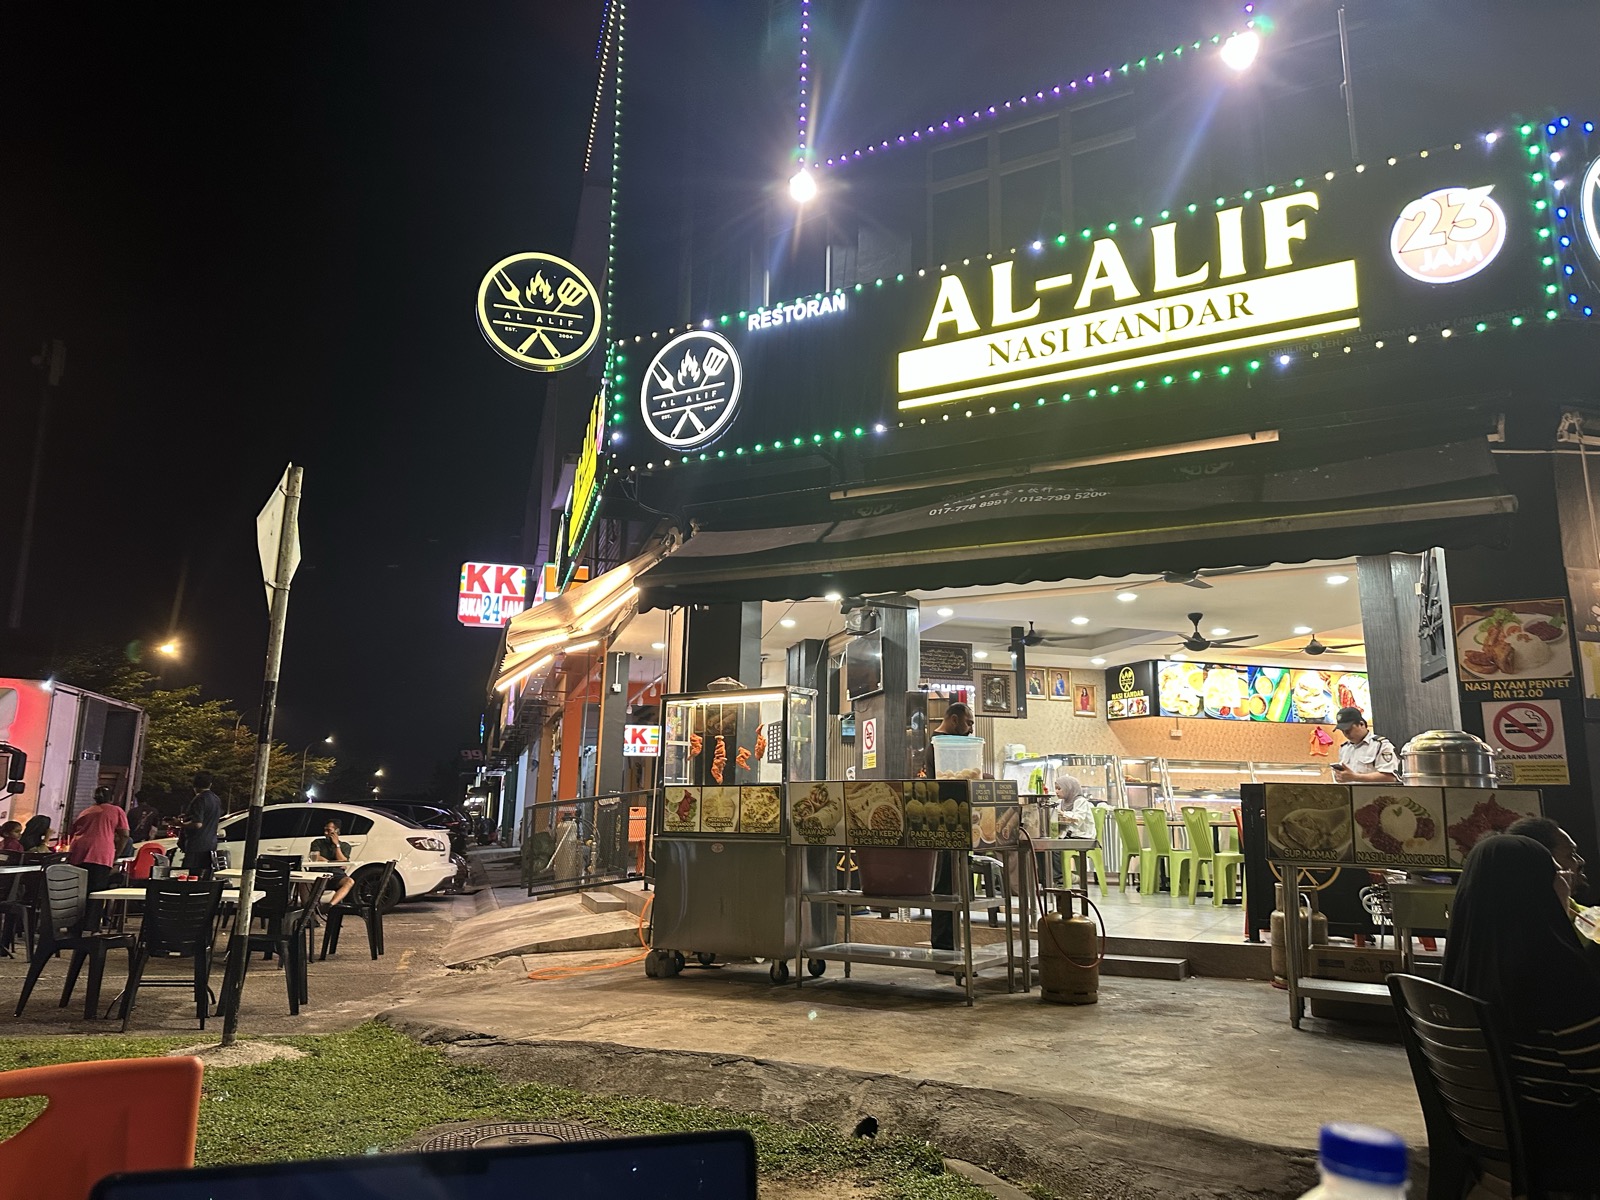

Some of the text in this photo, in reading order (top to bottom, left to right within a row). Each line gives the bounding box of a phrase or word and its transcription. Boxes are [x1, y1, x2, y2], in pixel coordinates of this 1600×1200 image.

[1399, 186, 1495, 253] 23
[1419, 243, 1484, 272] JAM
[922, 191, 1320, 341] AL-ALIF
[504, 311, 574, 327] AL ALIF
[748, 293, 846, 331] RESTORAN
[988, 291, 1255, 368] NASI KANDAR
[1346, 327, 1406, 344] RESTORAN
[661, 390, 717, 408] AL ALIF
[928, 504, 977, 517] 017-778
[978, 498, 1008, 509] 8991
[1019, 493, 1071, 504] 012-799
[460, 597, 482, 616] BUKA
[483, 595, 500, 621] 24
[1465, 679, 1571, 691] NASI AYAM PENYET
[1124, 690, 1145, 699] KANDAR
[1493, 689, 1544, 699] RM 12.00
[461, 749, 483, 760] 99
[799, 828, 836, 836] SHAWARMA
[879, 829, 903, 838] KEEMA
[929, 831, 945, 839] PURI
[952, 832, 966, 840] PCS
[1284, 849, 1337, 861] SUP MAMAK
[1357, 853, 1446, 865] NASI LEMAK KUKUS
